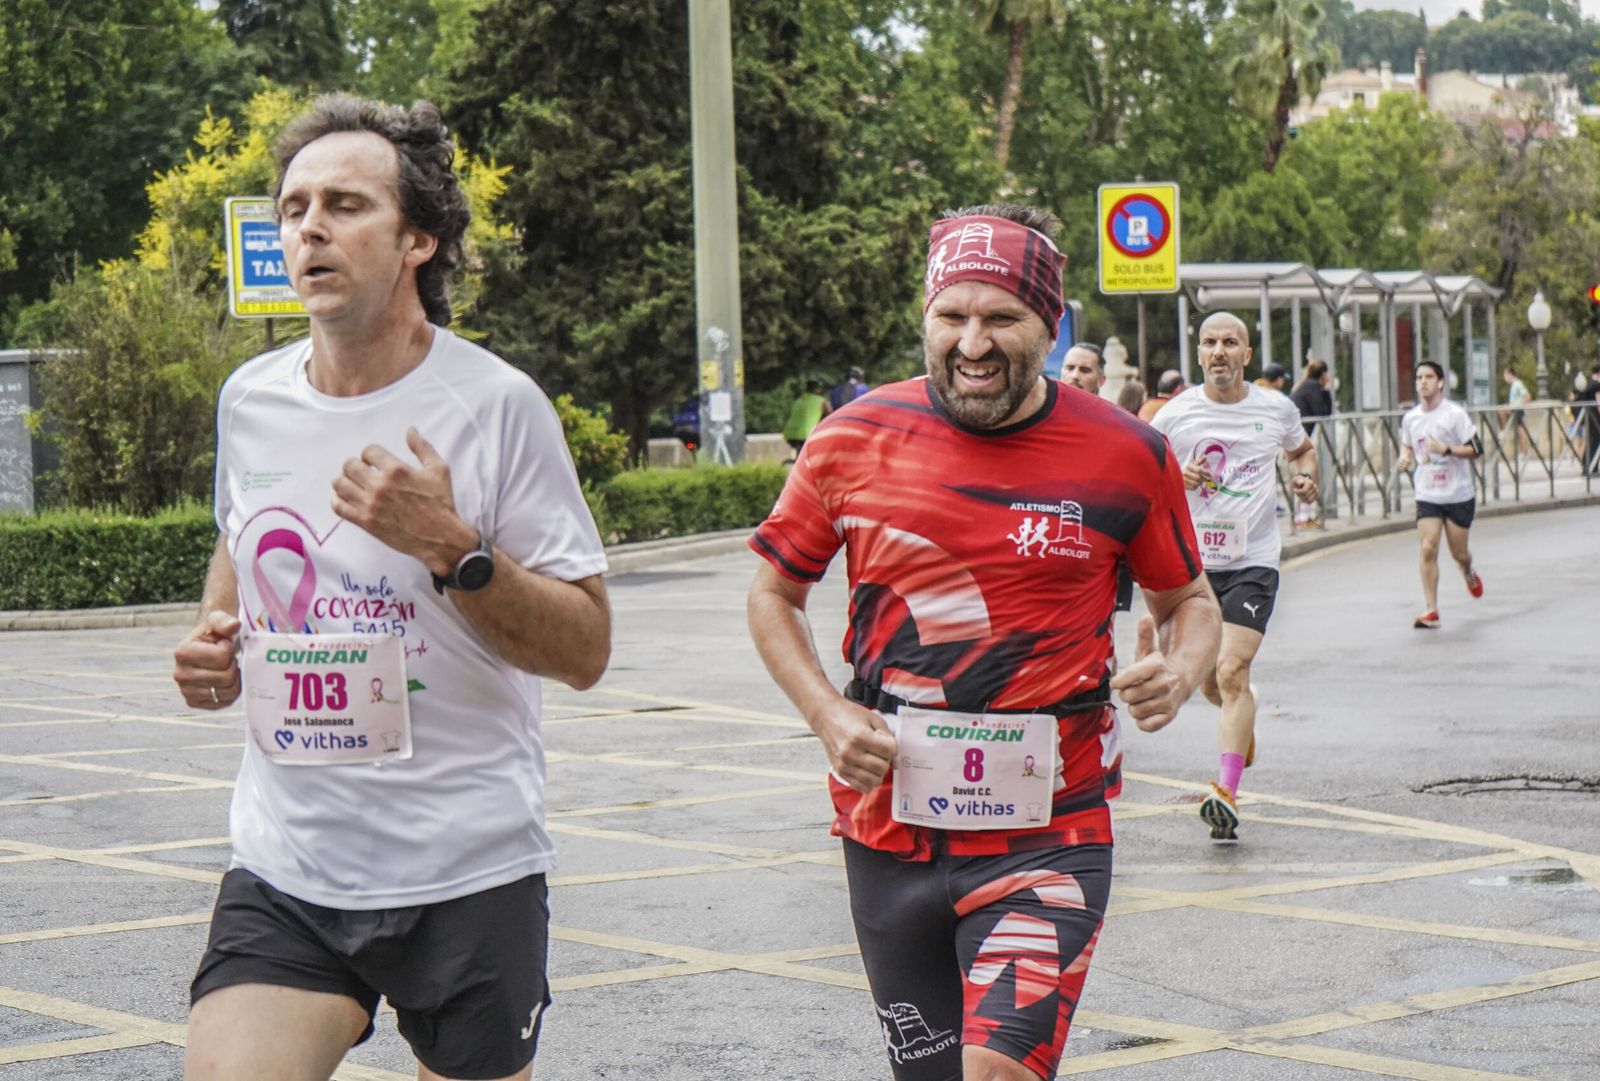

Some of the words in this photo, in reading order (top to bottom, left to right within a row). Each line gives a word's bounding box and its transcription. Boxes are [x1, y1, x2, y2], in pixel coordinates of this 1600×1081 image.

[251, 260, 288, 277] TAX
[945, 261, 1010, 276] ALBOLOTE
[1113, 264, 1141, 275] SOLO
[1143, 264, 1165, 274] BUS
[1009, 502, 1061, 513] ATLETISMO
[1203, 531, 1226, 546] 612
[1047, 546, 1091, 560] ALBOLOTE
[341, 572, 361, 592] Un
[366, 576, 395, 598] solo
[265, 649, 369, 664] COVIRAN
[284, 672, 348, 712] 703
[284, 717, 302, 727] Jose
[304, 717, 355, 727] Salamanca
[300, 732, 368, 750] vithas
[926, 725, 1025, 742] COVIRAN
[963, 747, 985, 783] 8
[952, 786, 976, 796] David
[977, 787, 993, 797] C.C.
[954, 800, 1015, 817] vithas
[901, 1035, 958, 1060] ALBOLOTE
